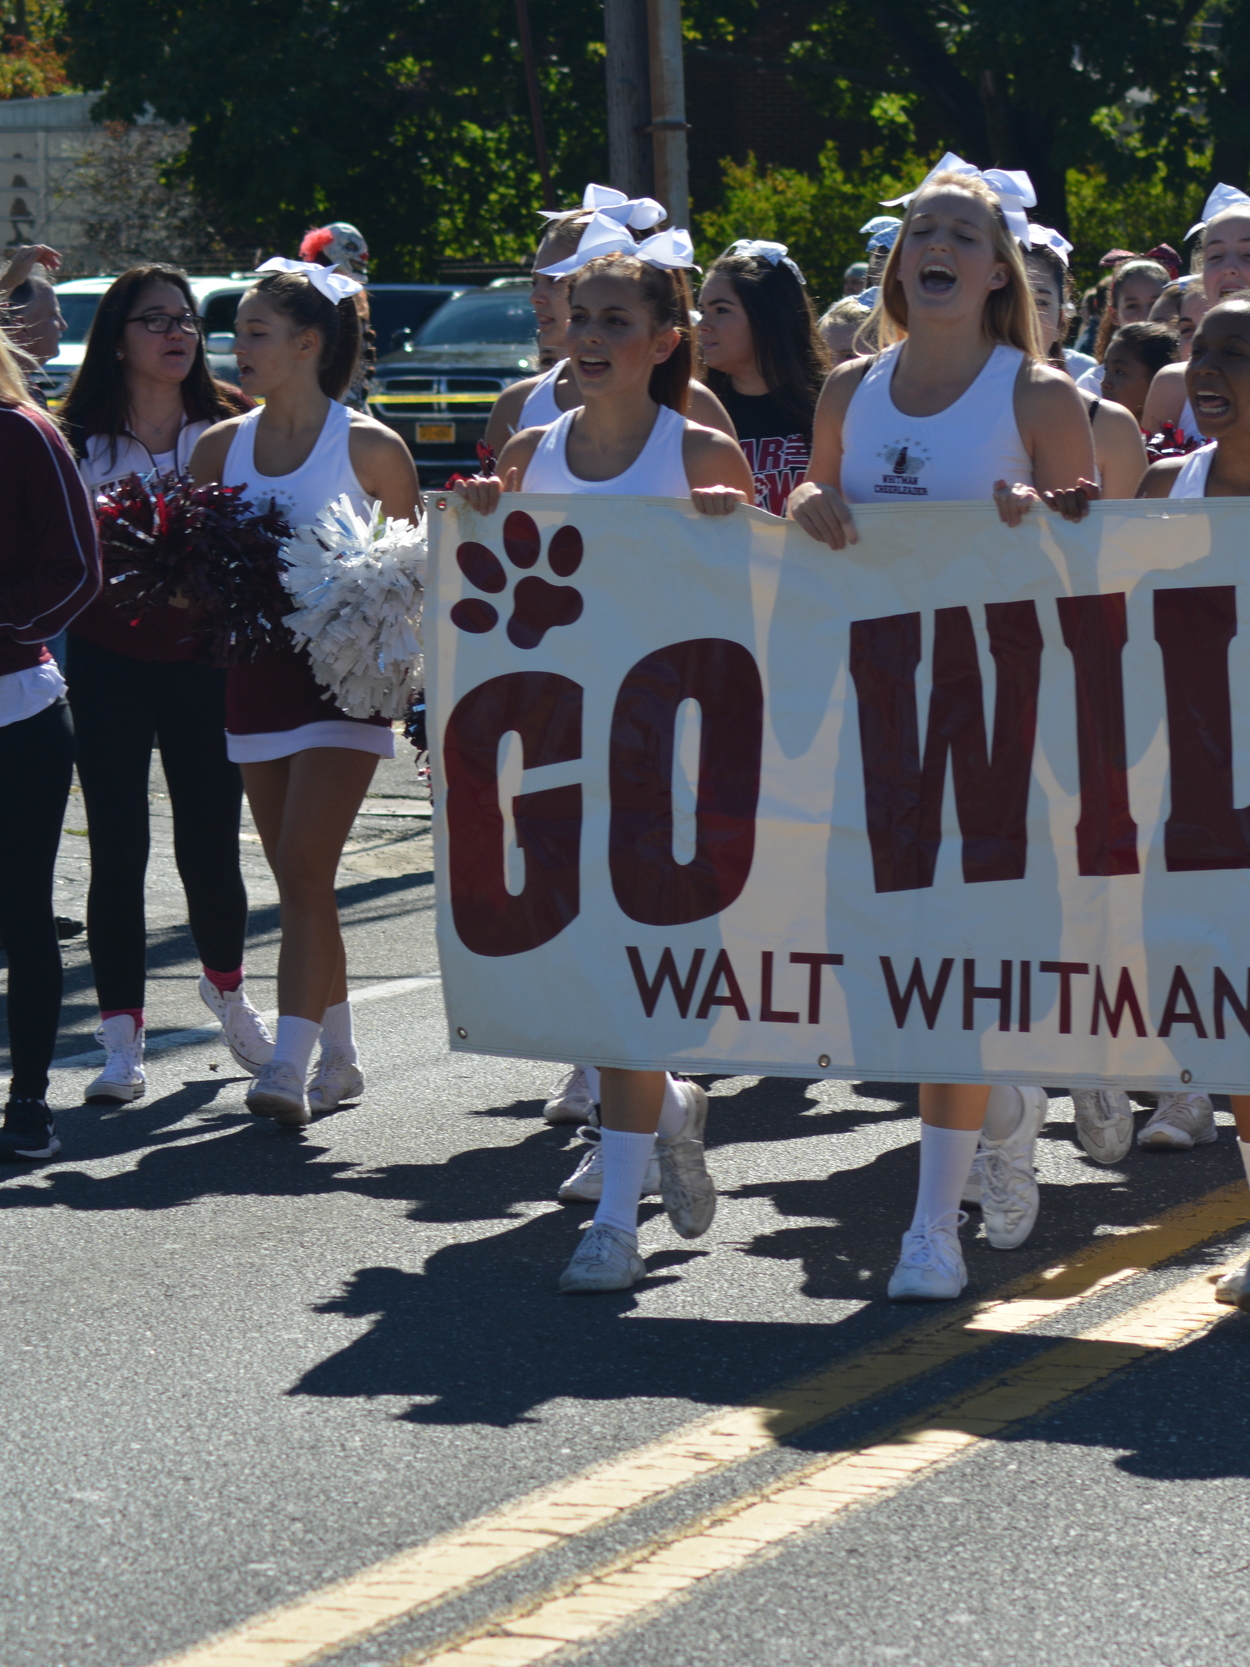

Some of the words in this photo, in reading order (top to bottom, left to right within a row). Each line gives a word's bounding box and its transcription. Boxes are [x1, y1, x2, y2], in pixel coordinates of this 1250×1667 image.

[874, 485, 928, 495] CHEERLEADER
[882, 475, 919, 485] WHITMAN
[443, 637, 764, 957] GO
[625, 946, 844, 1025] WALT
